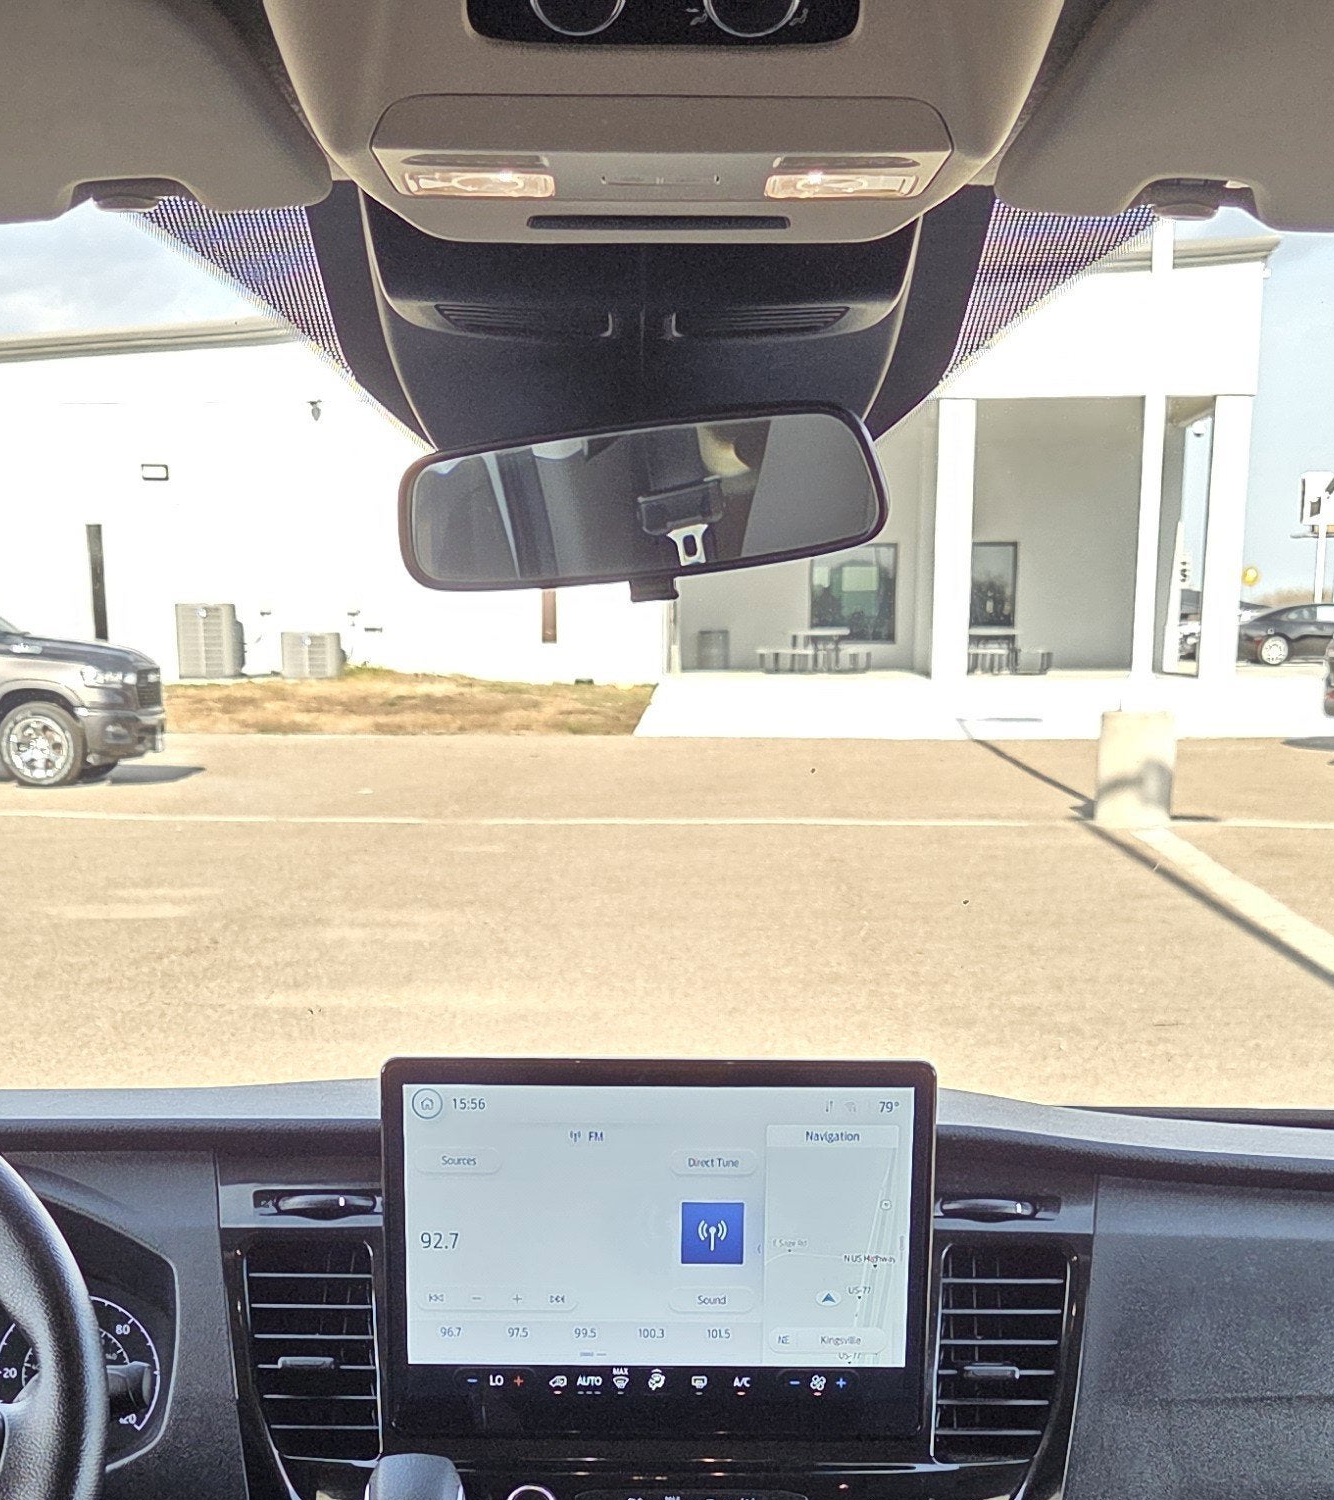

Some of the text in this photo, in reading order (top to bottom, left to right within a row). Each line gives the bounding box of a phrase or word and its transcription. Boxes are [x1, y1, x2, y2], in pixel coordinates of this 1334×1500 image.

[452, 1097, 486, 1111] 15:56
[588, 1131, 604, 1142] FM
[805, 1130, 860, 1143] Navigation
[441, 1155, 477, 1166] Sources
[688, 1157, 740, 1168] Direct Tune
[420, 1232, 459, 1250] 92.7
[697, 1294, 727, 1306] Sound
[115, 1324, 131, 1335] 80
[440, 1326, 462, 1338] 96.7
[508, 1326, 529, 1338] 97.5
[574, 1327, 597, 1338] 99.5
[638, 1327, 665, 1339] 100.3
[706, 1327, 731, 1339] 101.5
[2, 1367, 18, 1378] 20
[612, 1367, 629, 1376] MAX
[489, 1374, 504, 1387] LO
[576, 1374, 603, 1387] AUTO
[733, 1376, 751, 1388] A/C
